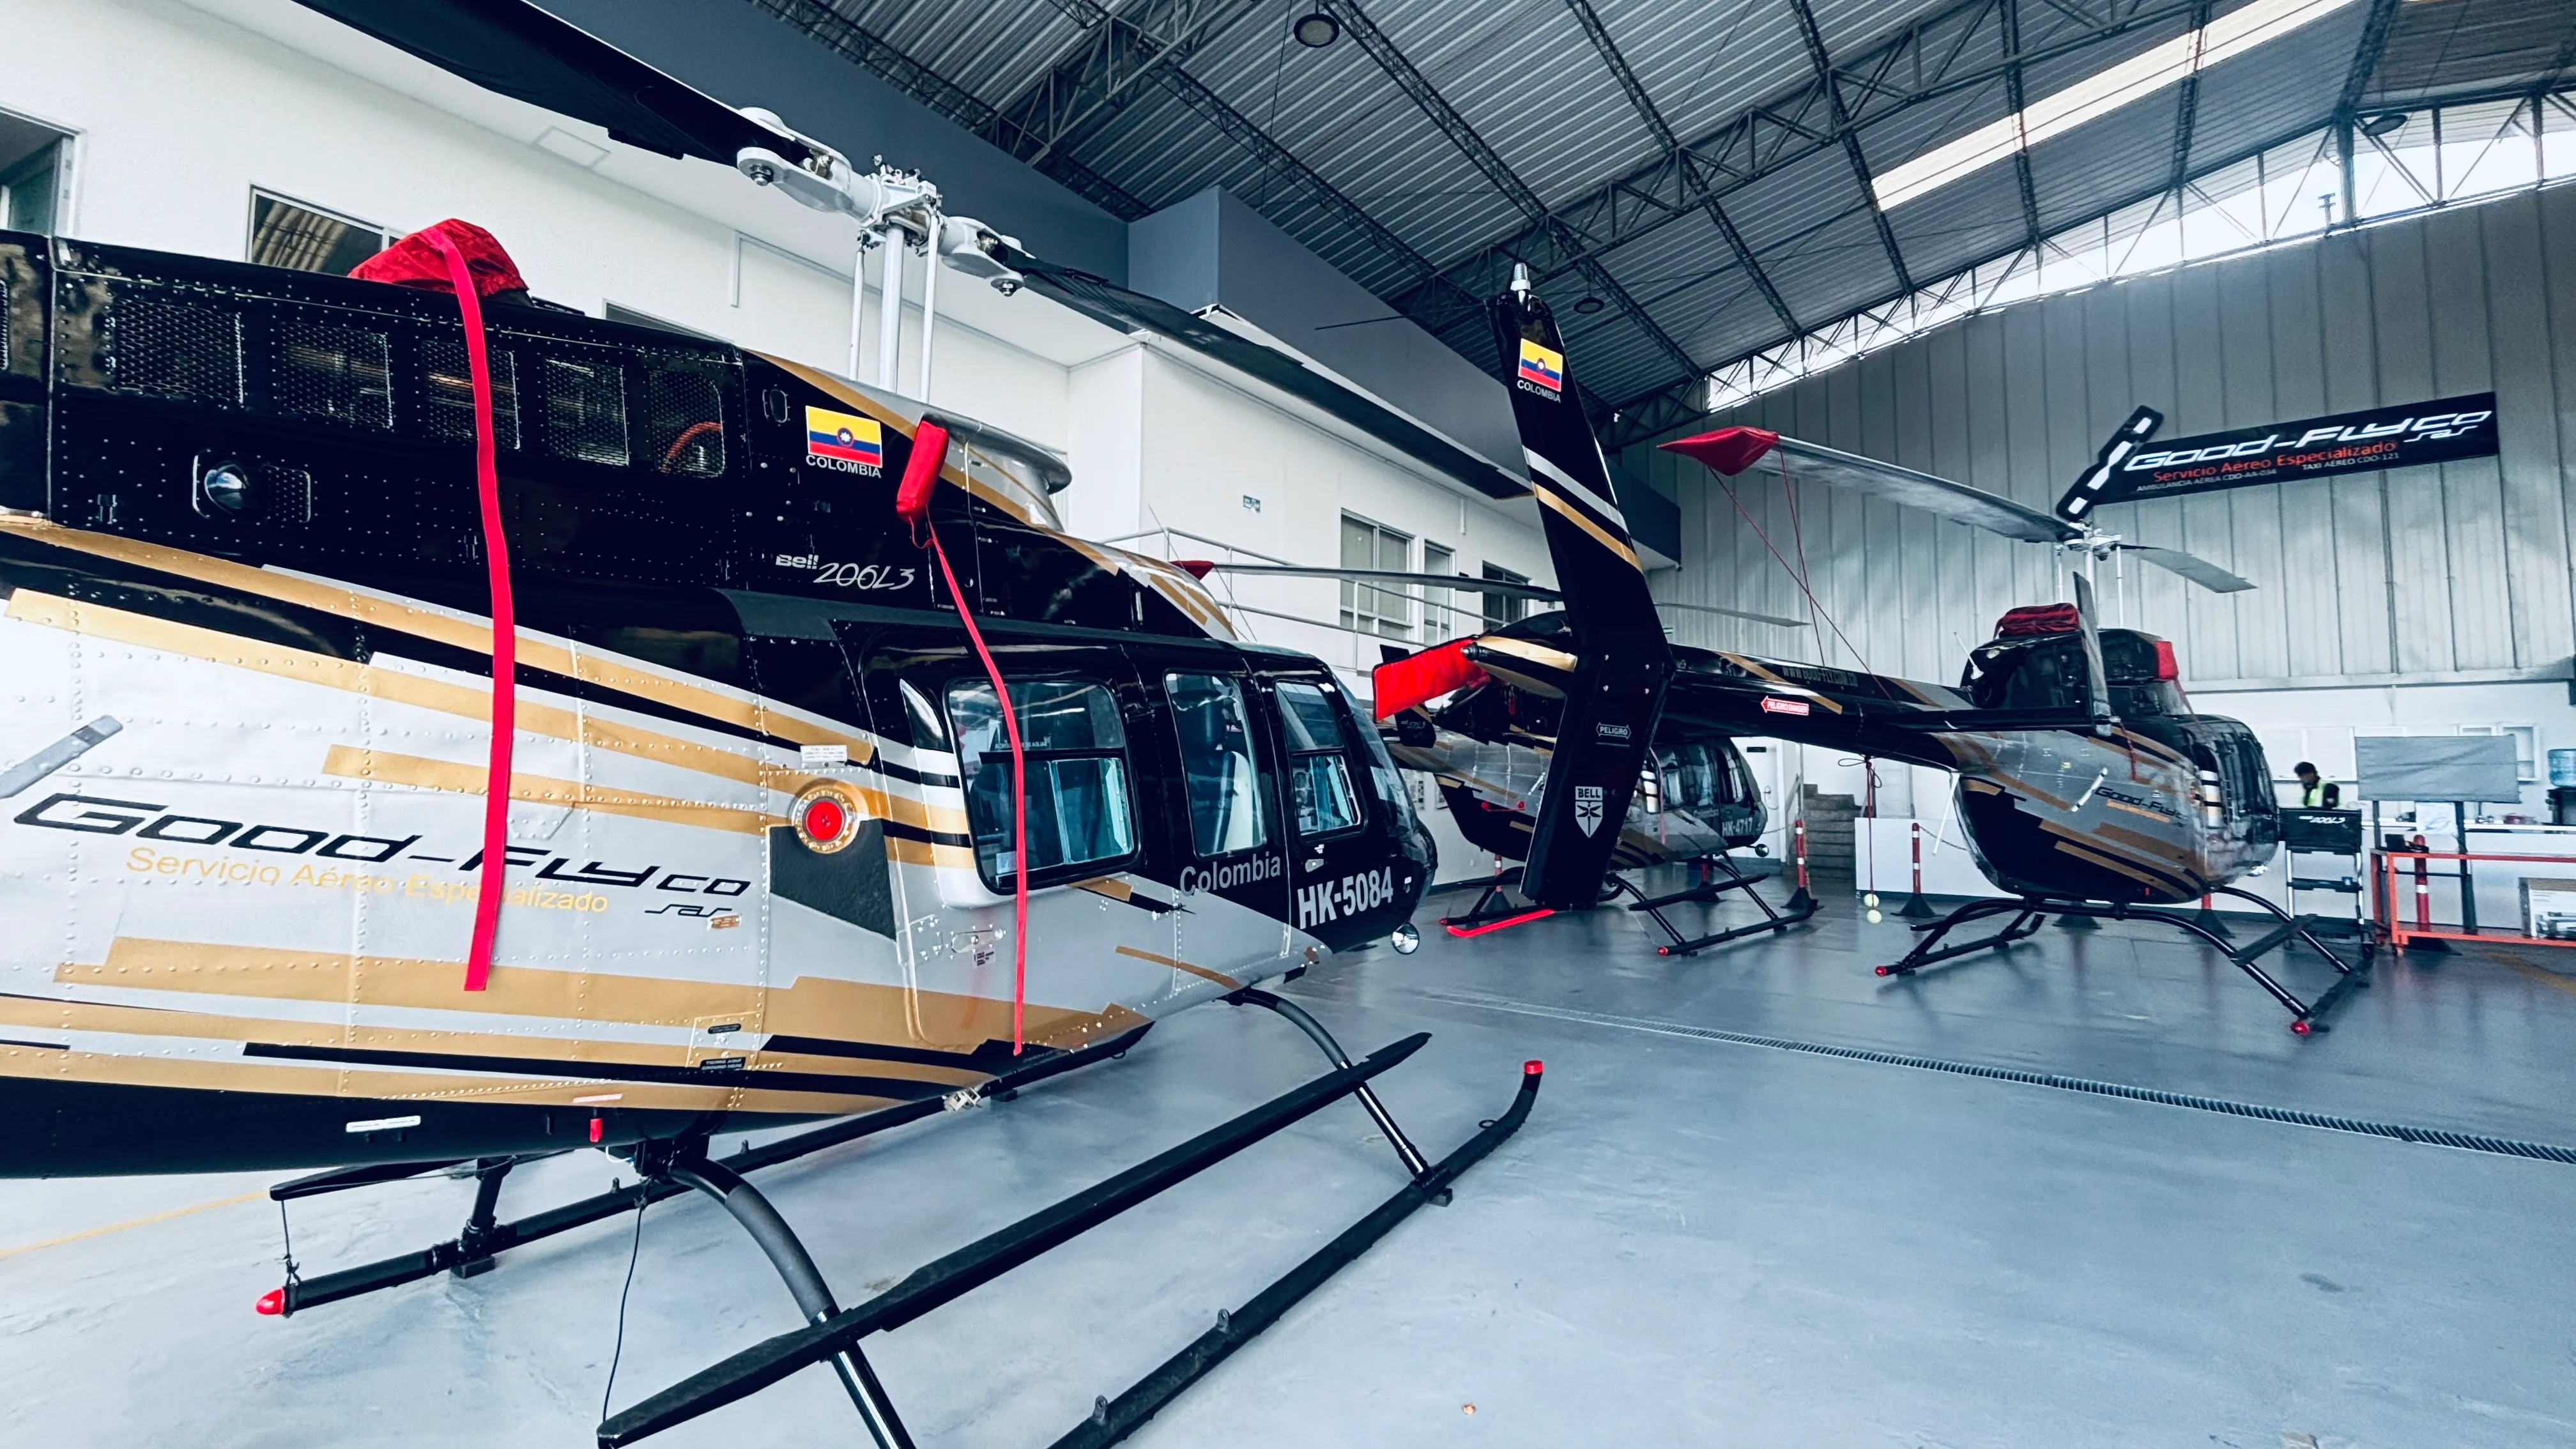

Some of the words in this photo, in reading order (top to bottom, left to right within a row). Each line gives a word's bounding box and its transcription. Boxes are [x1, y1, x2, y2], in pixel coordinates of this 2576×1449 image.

[1517, 379, 1561, 403] COLOMBIA
[806, 454, 882, 478] COLOMBIA
[2153, 465, 2216, 482] Servicio
[2221, 457, 2271, 473] Aéreo
[2276, 440, 2397, 466] Especializado
[2302, 463, 2322, 471] TAXI
[813, 562, 916, 590] 206L3
[1600, 726, 1628, 735] PELIGRO
[1577, 788, 1601, 798] BELL
[1722, 817, 1753, 837] HK-4717
[126, 847, 281, 884] Servicio
[289, 864, 394, 894] Aéreo
[406, 875, 608, 913] Espeializado
[1180, 851, 1281, 897] Colombia
[1297, 866, 1394, 930] HK-5084
